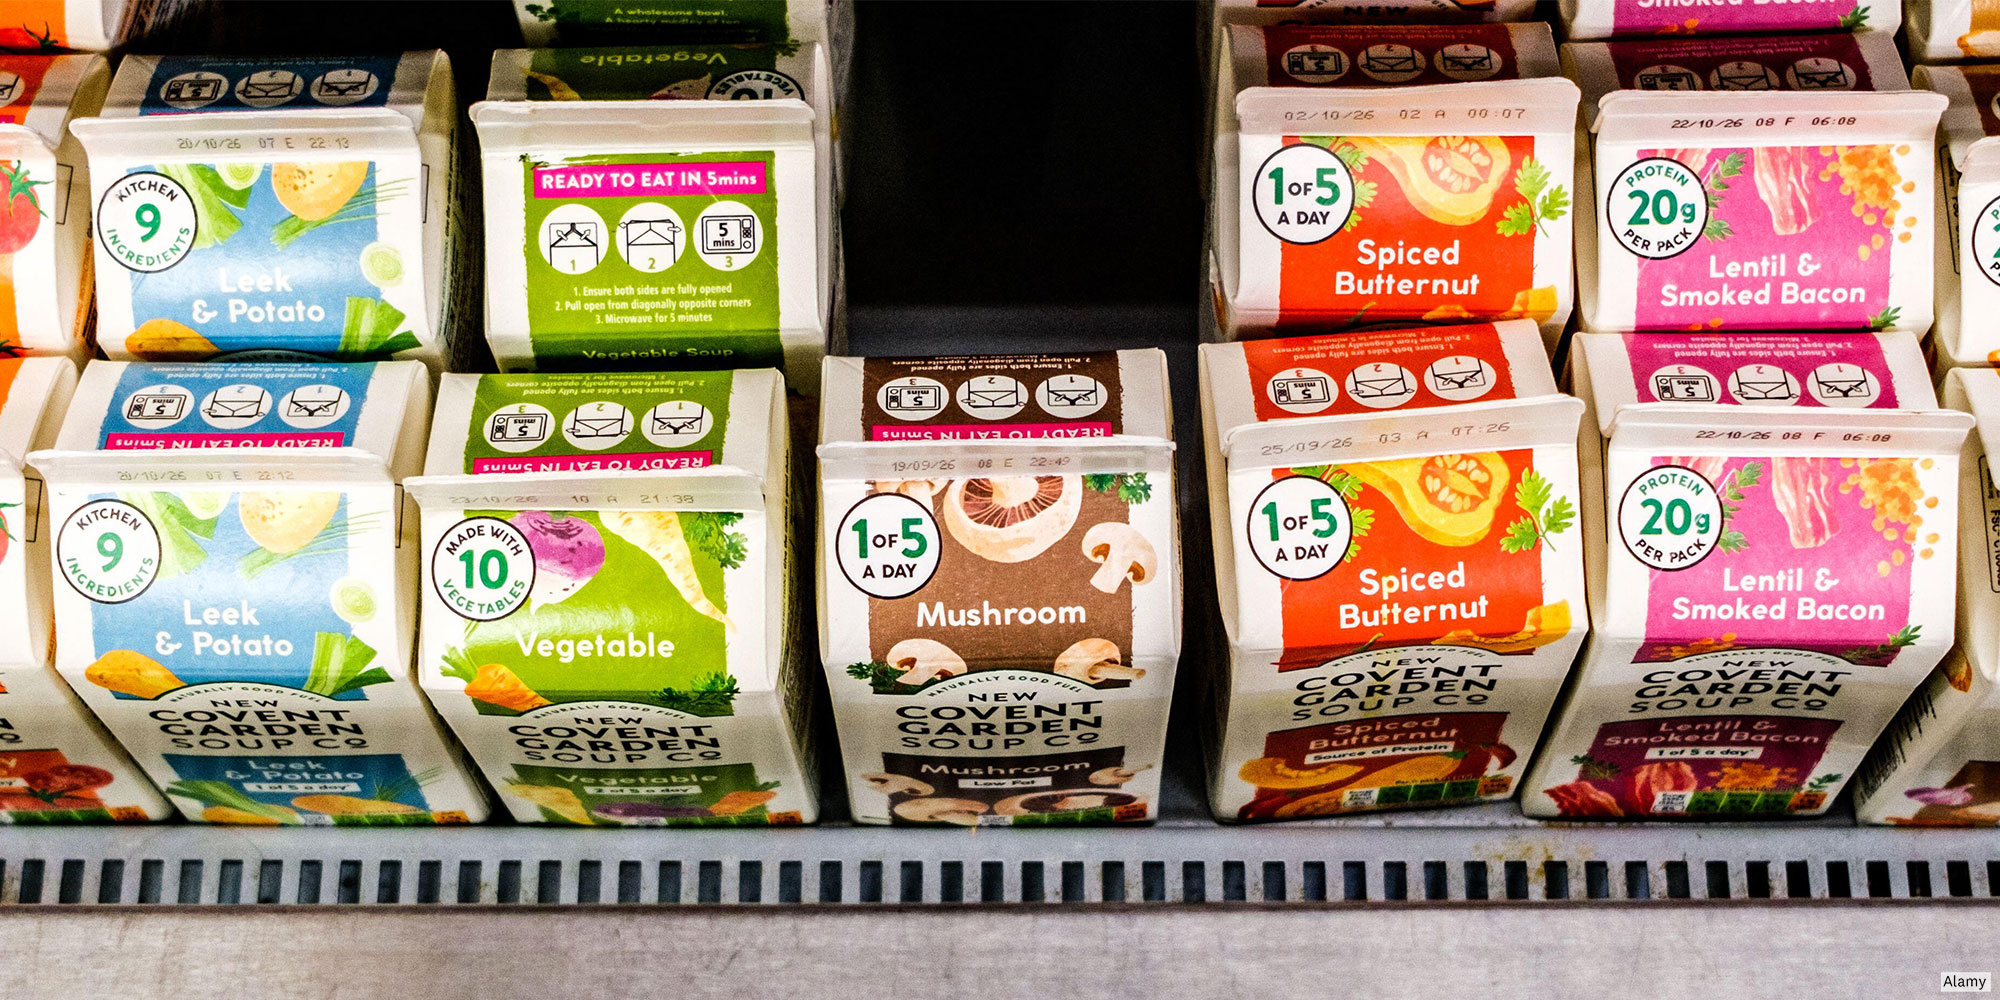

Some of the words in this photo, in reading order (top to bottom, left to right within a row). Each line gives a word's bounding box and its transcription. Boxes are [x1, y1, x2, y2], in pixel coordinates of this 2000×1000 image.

[580, 51, 728, 66] Vegetable
[1399, 109, 1421, 120] 02
[1434, 110, 1446, 119] A
[1755, 117, 1775, 127] 08
[1785, 117, 1794, 127] F
[542, 173, 604, 189] READY
[610, 173, 635, 188] TO
[642, 171, 675, 187] EAT
[681, 171, 701, 186] IN
[708, 171, 757, 186] 5mins
[1268, 167, 1284, 205] 1
[1288, 182, 1313, 196] OF
[1315, 167, 1341, 206] 5
[1625, 165, 1690, 188] PROTEIN
[115, 179, 179, 203] KITCHEN
[1627, 189, 1696, 226] 20g
[135, 203, 161, 243] 9
[1277, 211, 1290, 225] A
[1296, 211, 1331, 225] DAY
[718, 222, 728, 237] 5
[1623, 228, 1651, 252] PER
[1657, 227, 1692, 252] PACK
[106, 225, 191, 266] INGREDIENTS
[713, 237, 735, 248] mins
[1357, 239, 1460, 270] Spiced
[1709, 253, 1786, 279] Lentil
[1797, 252, 1822, 276] &
[219, 267, 293, 293] Leek
[573, 287, 581, 296] 1.
[583, 286, 612, 296] Ensure
[614, 285, 635, 295] both
[636, 284, 659, 295] sides
[660, 286, 676, 295] are
[677, 283, 697, 297] fully
[699, 283, 732, 296] opened
[1335, 271, 1480, 296] Butternut
[1660, 281, 1771, 307] Smoked
[1781, 282, 1866, 305] Bacon
[192, 299, 217, 323] &
[230, 298, 324, 323] Potato
[555, 302, 563, 311] 2.
[565, 301, 582, 311] Pull
[584, 302, 606, 313] open
[608, 300, 629, 310] from
[631, 299, 677, 312] diagonally
[679, 299, 717, 311] opposite
[719, 299, 752, 308] corners
[596, 315, 604, 324] 3.
[605, 314, 653, 324] Microwave
[654, 313, 669, 323] for
[670, 314, 676, 322] 5
[677, 313, 712, 322] minutes
[582, 348, 678, 360] Vegetable
[686, 347, 733, 358] Soup
[1379, 432, 1401, 444] 03
[1417, 431, 1429, 440] A
[1781, 431, 1802, 441] 08
[1814, 431, 1825, 442] F
[978, 459, 992, 469] 08
[1004, 458, 1013, 468] E
[1639, 473, 1704, 496] PROTEIN
[76, 508, 141, 531] KITCHEN
[1261, 501, 1280, 542] 1
[1283, 515, 1309, 531] OF
[1310, 498, 1338, 539] 5
[1639, 498, 1711, 536] 20g
[445, 525, 486, 556] MADE
[491, 526, 524, 557] WITH
[851, 518, 868, 559] 1
[872, 534, 899, 549] OF
[901, 517, 928, 559] 5
[97, 532, 123, 572] 9
[1275, 548, 1288, 562] A
[1294, 544, 1329, 561] DAY
[1635, 539, 1662, 562] PER
[1670, 538, 1707, 563] PACK
[66, 557, 153, 597] INGREDIENTS
[459, 549, 508, 590] 10
[862, 564, 875, 579] A
[882, 563, 917, 579] DAY
[1359, 561, 1466, 599] Spiced
[1723, 567, 1803, 593] Lentil
[1813, 568, 1840, 591] &
[442, 579, 526, 614] VEGETABLES
[184, 600, 259, 626] Leek
[917, 600, 1086, 627] Mushroom
[1339, 596, 1489, 630] Butternut
[1672, 596, 1785, 622] Smoked
[1798, 597, 1886, 621] Bacon
[155, 632, 182, 655] &
[194, 631, 293, 656] Potato
[515, 631, 675, 663] Vegetable
[1372, 656, 1442, 668] NEW
[1722, 660, 1796, 668] NEW
[928, 675, 1000, 698] NATURALLY
[1008, 675, 1049, 684] GOOD
[1054, 681, 1082, 693] FUEL
[1296, 664, 1503, 692] COVENT
[1642, 669, 1852, 684] COVENT
[968, 692, 1038, 702] NEW
[1293, 678, 1497, 707] GARDEN
[1634, 682, 1842, 699] GARDEN
[896, 700, 1103, 720] COVENT
[1292, 696, 1415, 721] SOUP
[1628, 697, 1752, 714] SOUP
[149, 710, 350, 722] COVENT
[574, 717, 643, 725] NEW
[897, 716, 1102, 736] GARDEN
[160, 724, 364, 736] GARDEN
[508, 725, 713, 739] COVENT
[1334, 717, 1441, 736] Spiced
[1659, 720, 1741, 733] Lentil
[1752, 721, 1777, 731] &
[171, 738, 293, 749] SOUP
[515, 737, 721, 751] GARDEN
[901, 737, 1025, 750] SOUP
[1309, 728, 1459, 751] Butternut
[1604, 731, 1720, 747] Smoked
[1730, 731, 1820, 744] Bacon
[524, 751, 647, 763] SOUP
[1313, 751, 1367, 762] Source
[1372, 747, 1387, 756] of
[1391, 743, 1448, 754] Protein
[225, 770, 251, 779] &
[264, 769, 364, 780] Potato
[249, 760, 325, 770] Leek
[920, 761, 1091, 774] Mushroom
[555, 773, 718, 785] Vegetable
